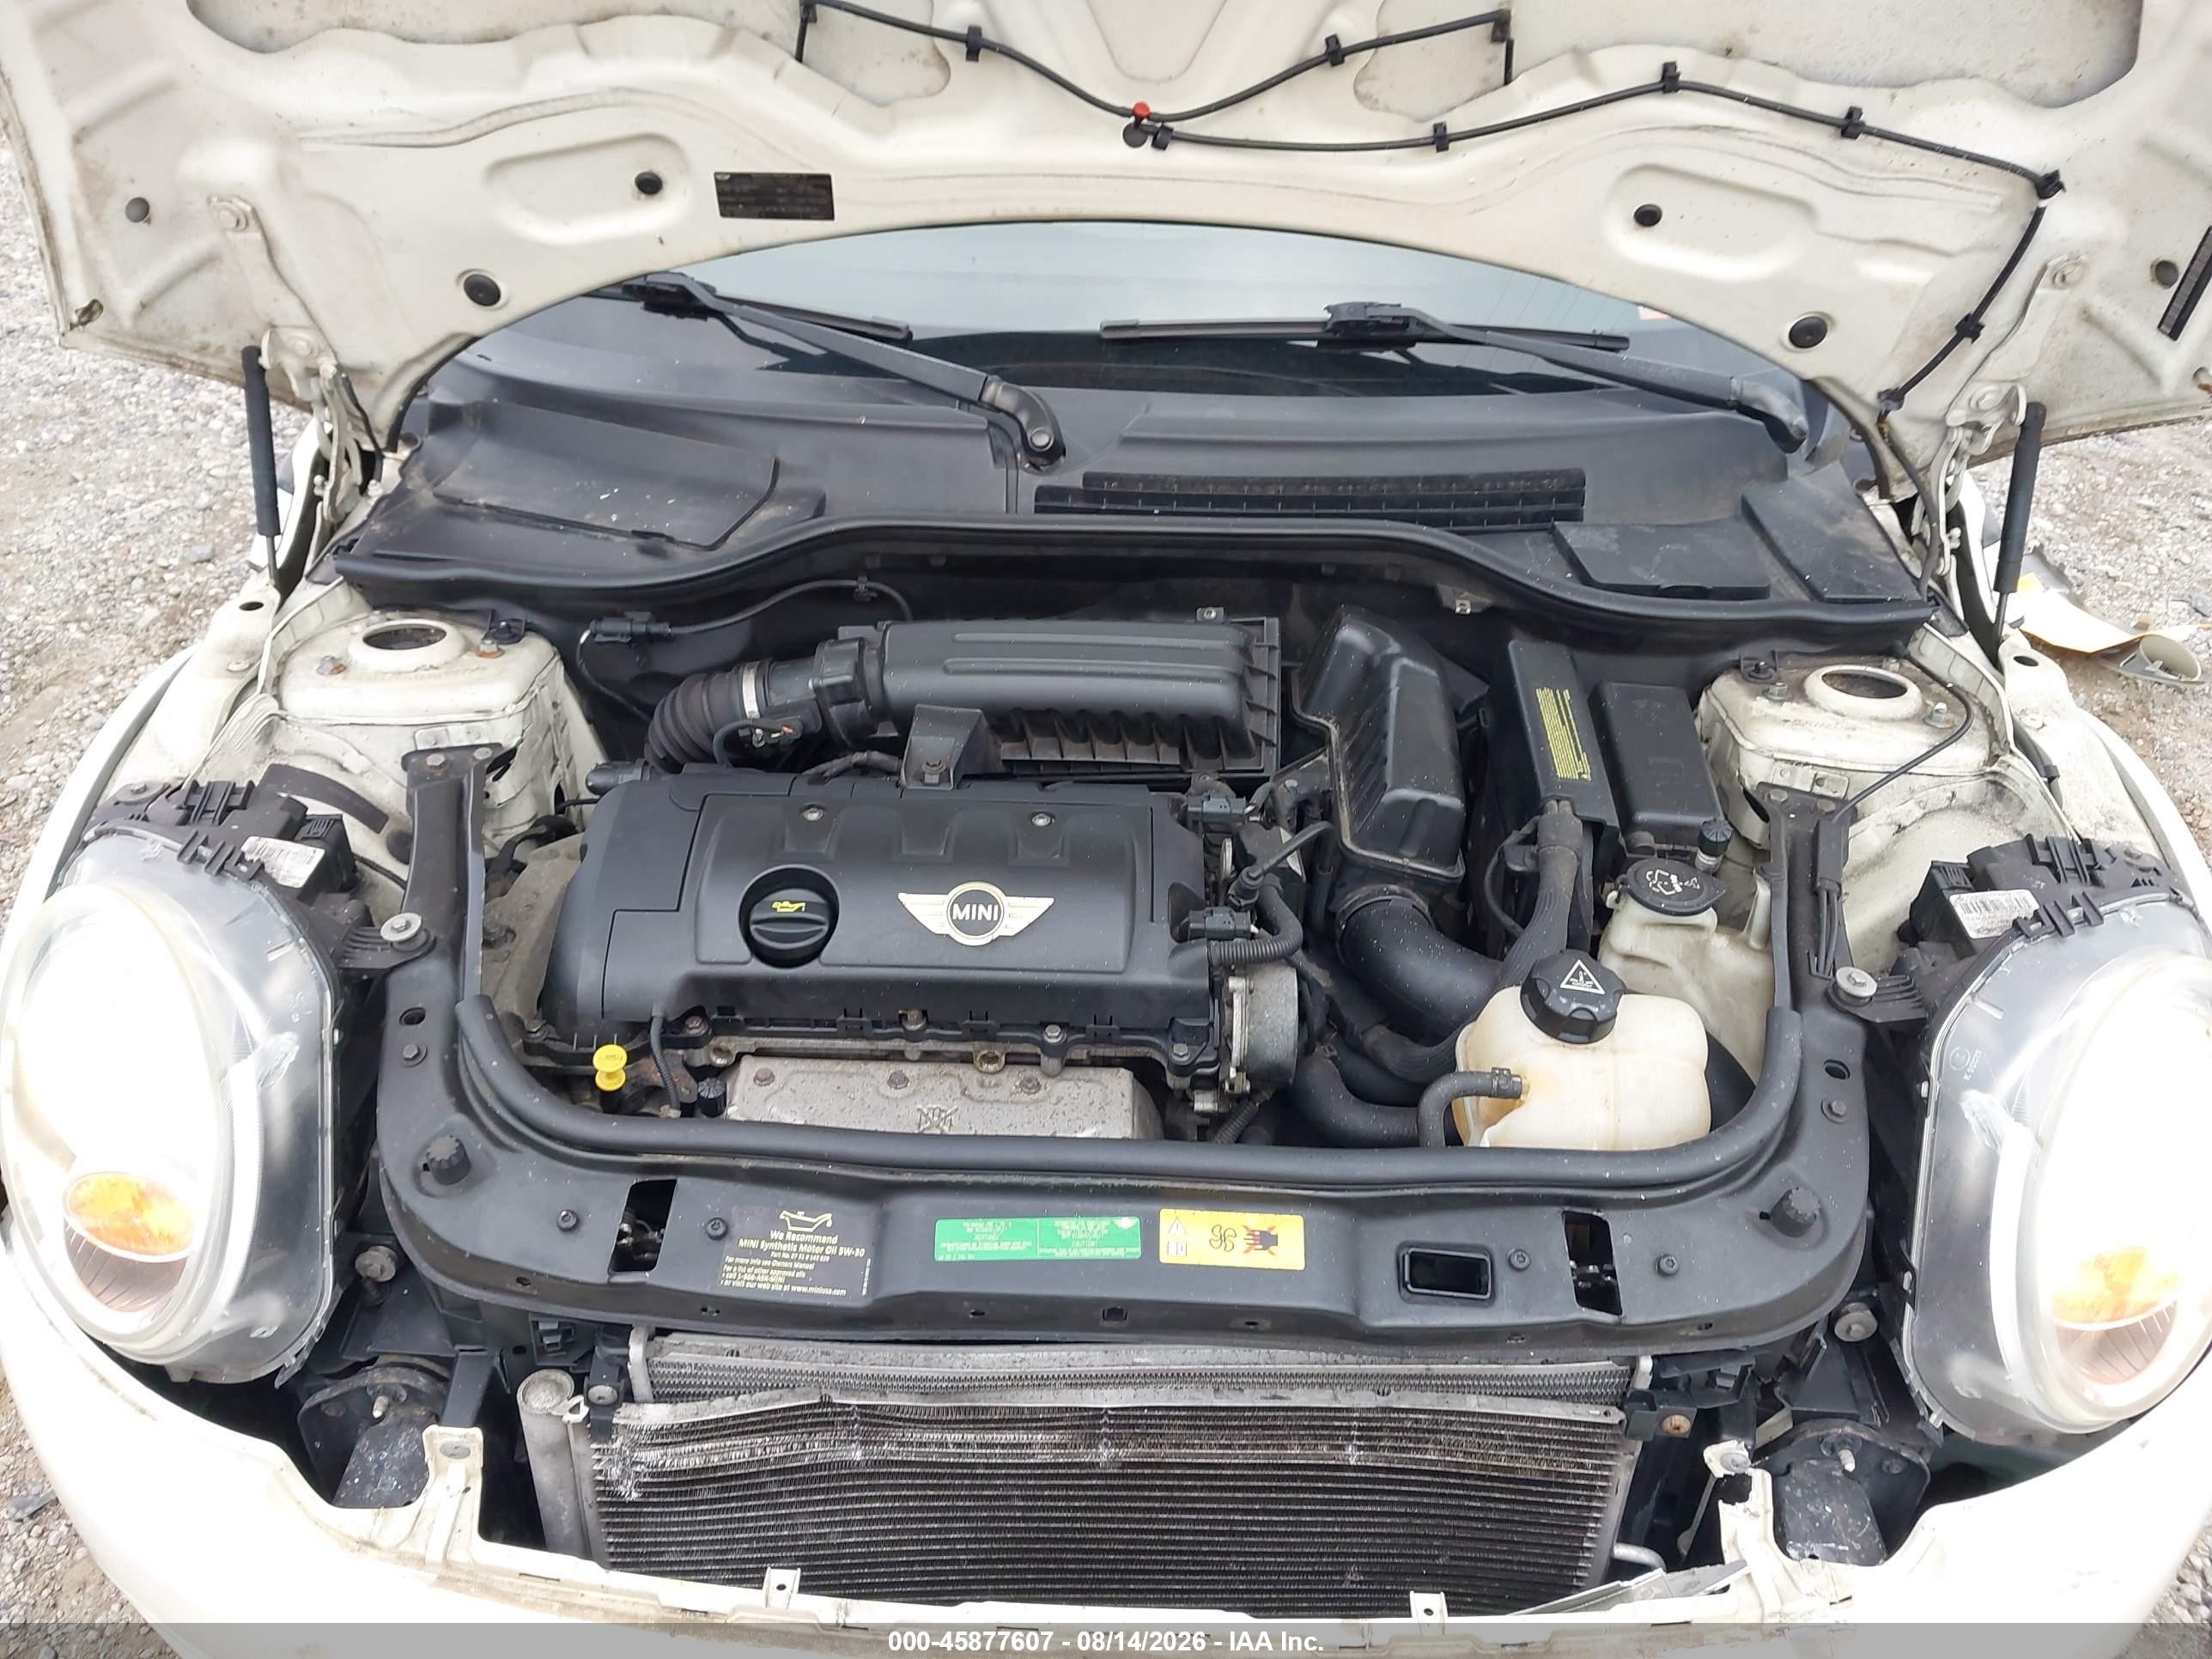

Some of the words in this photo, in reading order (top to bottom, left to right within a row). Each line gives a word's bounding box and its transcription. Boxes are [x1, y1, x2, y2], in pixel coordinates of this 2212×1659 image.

[952, 902, 1000, 921] MINI
[769, 1230, 784, 1240] We
[786, 1231, 838, 1244] Recommend
[738, 1238, 759, 1249] MINI
[760, 1240, 797, 1253] Synthetic
[799, 1244, 824, 1255] Motor
[824, 1245, 836, 1255] Oil
[838, 1246, 866, 1258] 5W-30
[750, 1257, 762, 1266] info
[769, 1268, 796, 1278] approved
[791, 1285, 847, 1296] www.miniusa.com
